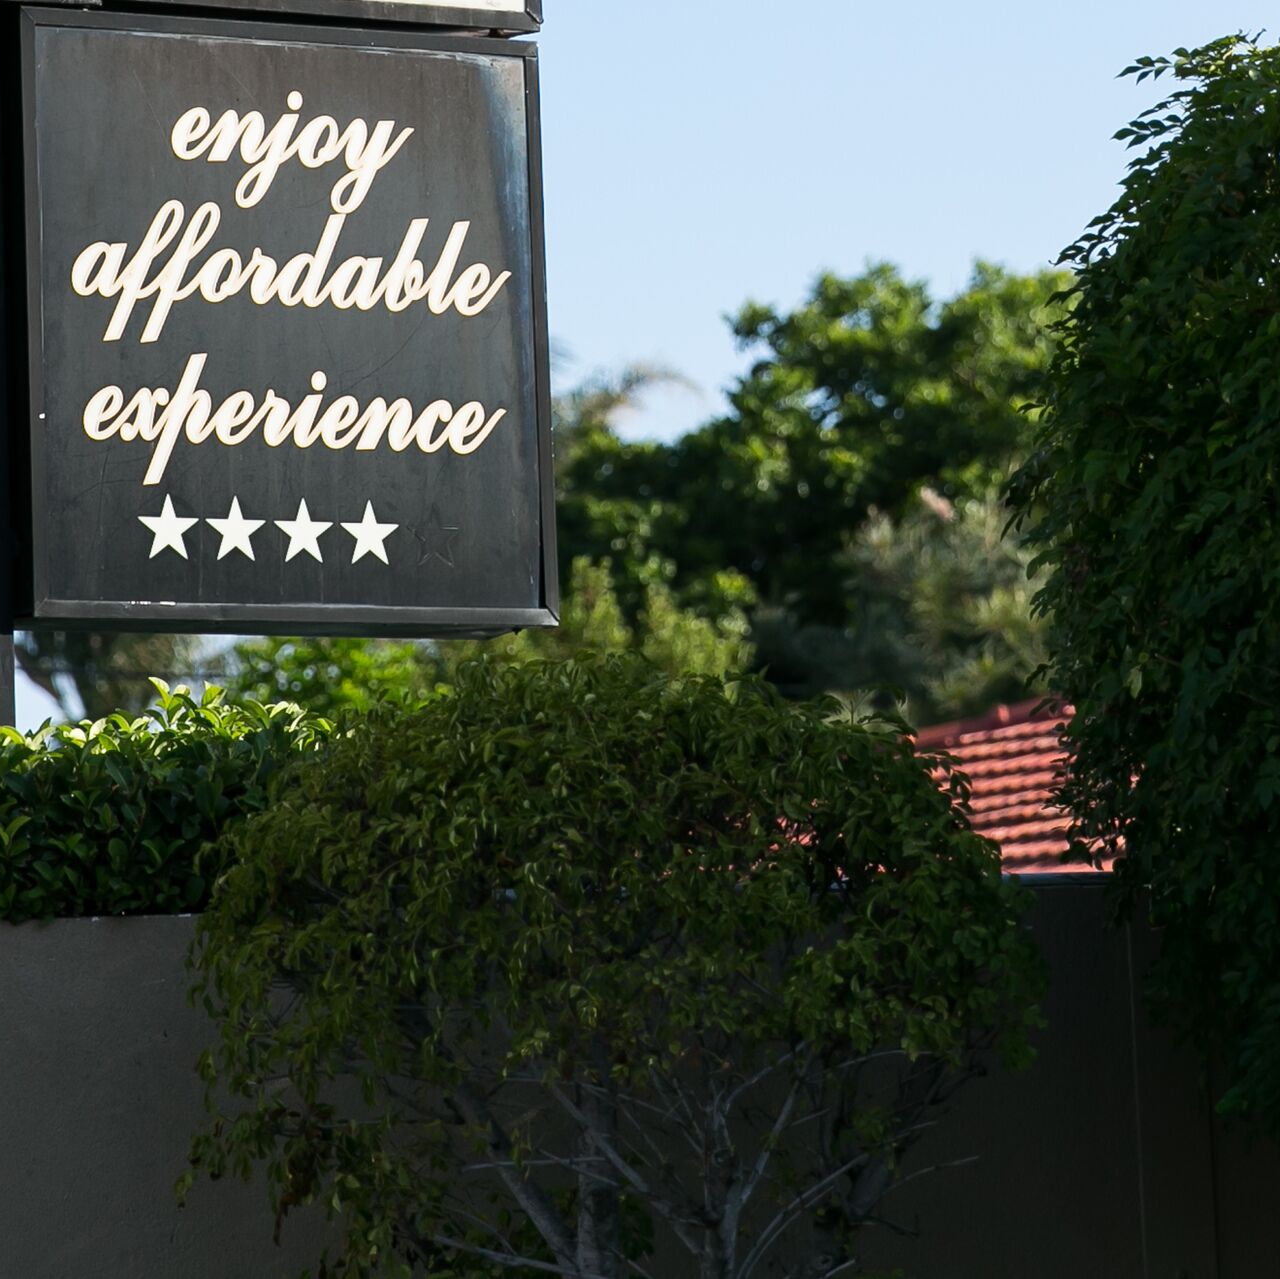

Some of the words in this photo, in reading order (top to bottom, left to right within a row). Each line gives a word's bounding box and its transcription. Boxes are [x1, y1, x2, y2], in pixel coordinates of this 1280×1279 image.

[171, 90, 416, 214] enjoy
[71, 199, 512, 344] affordable
[82, 352, 507, 486] experience
